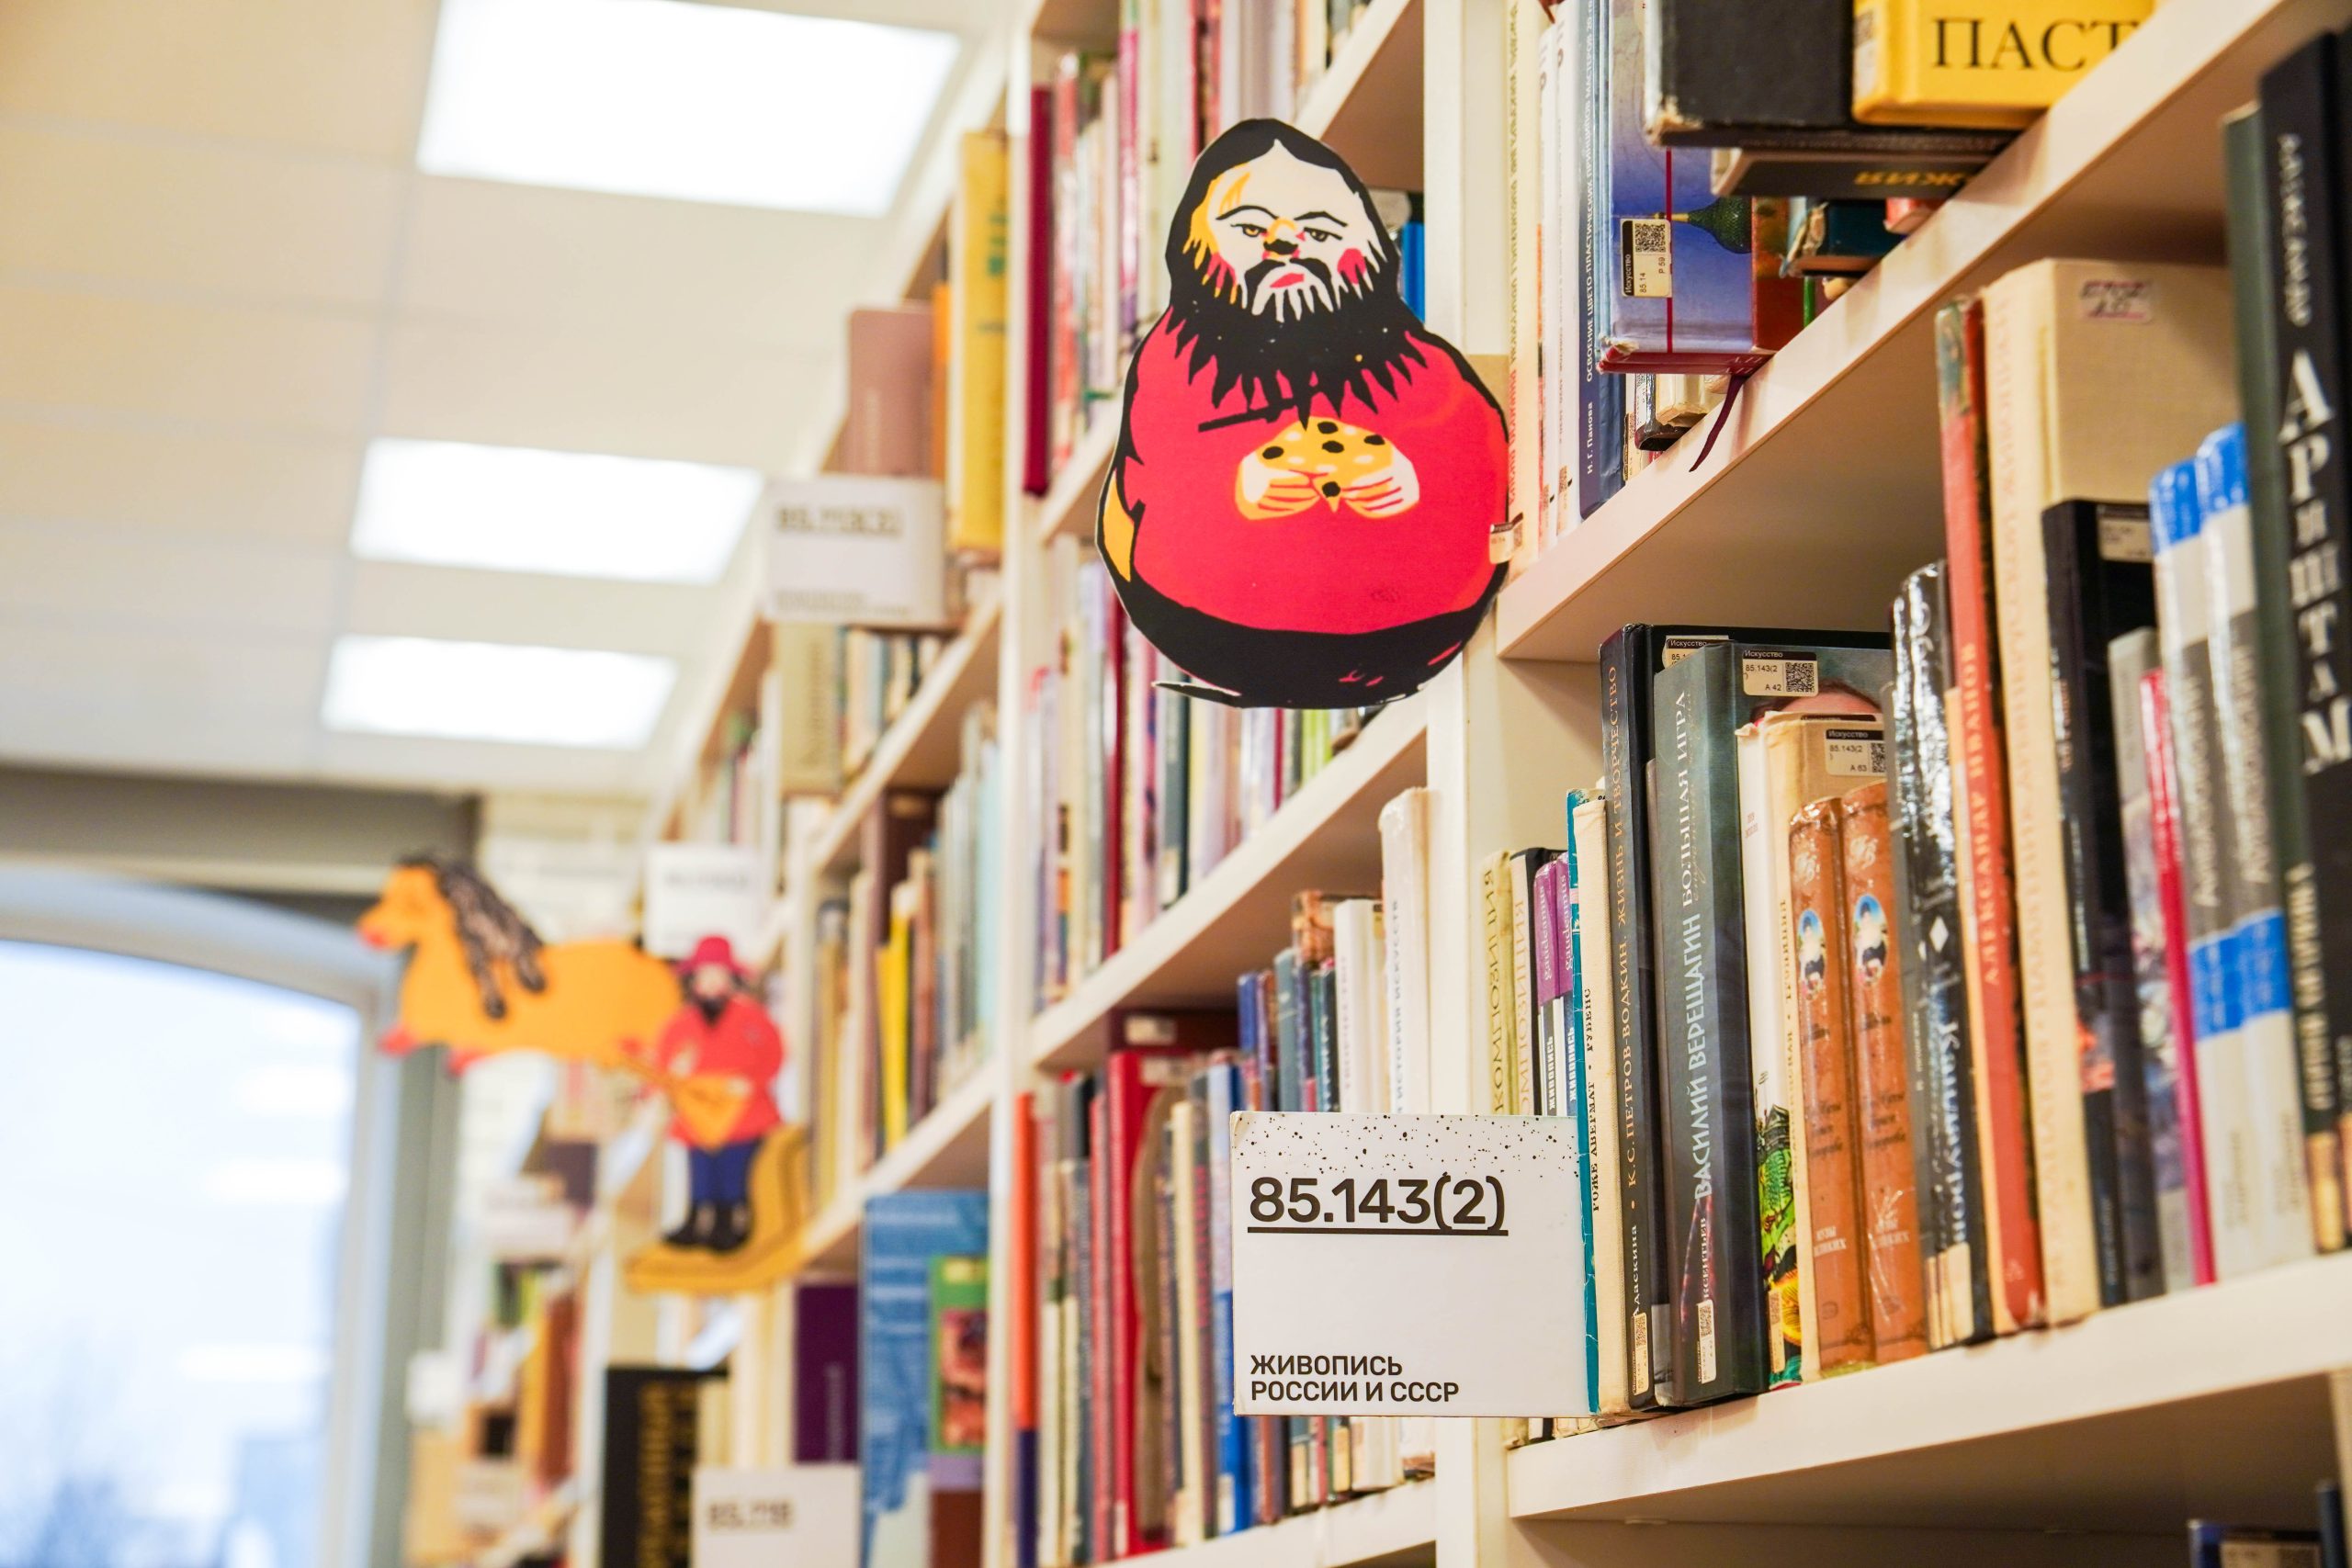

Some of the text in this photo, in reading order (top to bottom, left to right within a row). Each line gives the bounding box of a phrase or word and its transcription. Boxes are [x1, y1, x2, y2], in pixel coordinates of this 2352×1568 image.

[1583, 100, 1593, 176] ПРИНЦИПОВ
[1585, 180, 1594, 316] ЦВЕТО-ПЛАСТИЧЕСКИХ
[1586, 318, 1594, 383] ОСВОЕНИЕ
[1586, 401, 1594, 449] Панова
[1744, 649, 1784, 658] Искусство
[1608, 665, 1623, 815] ТВОРЧЕСТВО
[1674, 689, 1688, 760] ИГРА
[1827, 730, 1870, 739] Искусство
[1613, 822, 1623, 836] И
[1677, 770, 1693, 908] БОЛЬШАЯ
[1960, 642, 1999, 985] АЛЕКСАНДР ИВАНОВ
[1537, 885, 1553, 981] gaudeamus
[1560, 874, 1572, 971] gaudeamus
[1615, 844, 1626, 928] ЖИЗНЬ
[1391, 899, 1401, 1000] ИСКУССТВ
[1484, 869, 1504, 1111] КОМПОЗИЦИЯ
[1682, 913, 1707, 1069] ВЕРЕЩАГИН
[1395, 1006, 1404, 1100] ИСТОРИЯ
[1514, 900, 1531, 1114] ОМПОЗИЦИЯ
[1583, 987, 1600, 1213] РОЖЕ АВЕРМАТ РУБЕНС
[1686, 1075, 1713, 1201] ВАСИЛИЙ
[1250, 1174, 1506, 1233] 85.143(2)
[1700, 1217, 1710, 1303] КСЕНТЬЕВ
[1250, 1353, 1403, 1377] ЖИВОПИСЬ
[1250, 1380, 1461, 1404] РОССИИ И СССР
